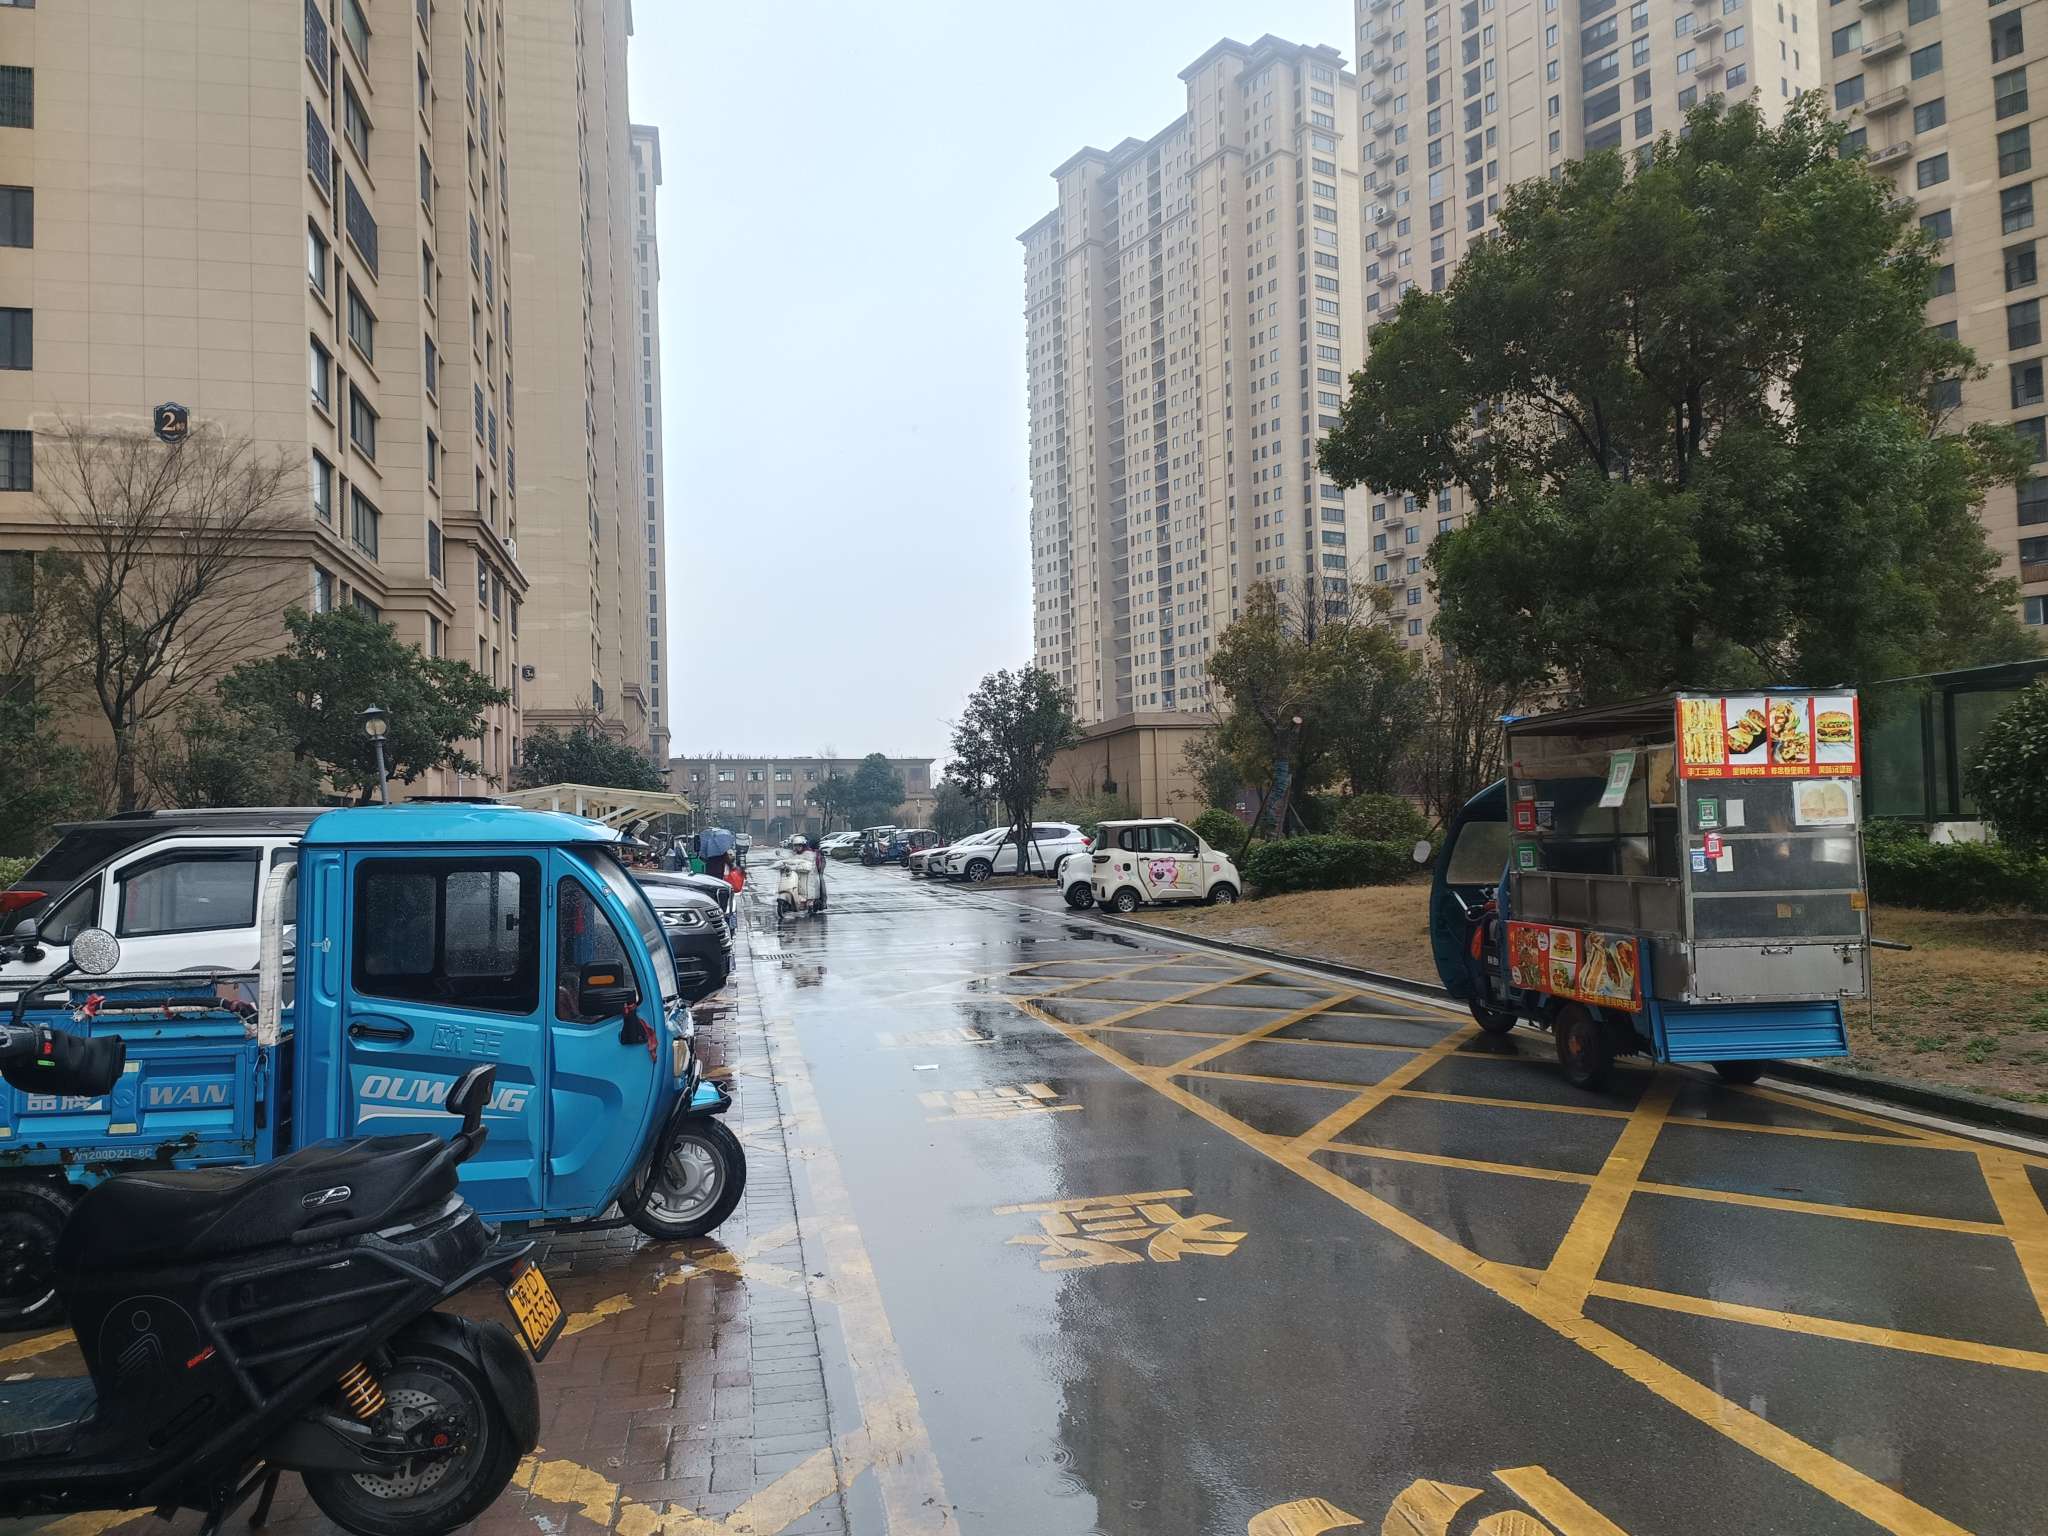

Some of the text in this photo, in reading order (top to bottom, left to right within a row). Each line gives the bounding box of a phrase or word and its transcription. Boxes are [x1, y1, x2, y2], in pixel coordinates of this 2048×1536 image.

[431, 1023, 505, 1057] 欧王
[149, 1084, 227, 1105] WAN
[359, 1075, 528, 1112] OUWNG
[523, 1290, 558, 1345] Z3539
